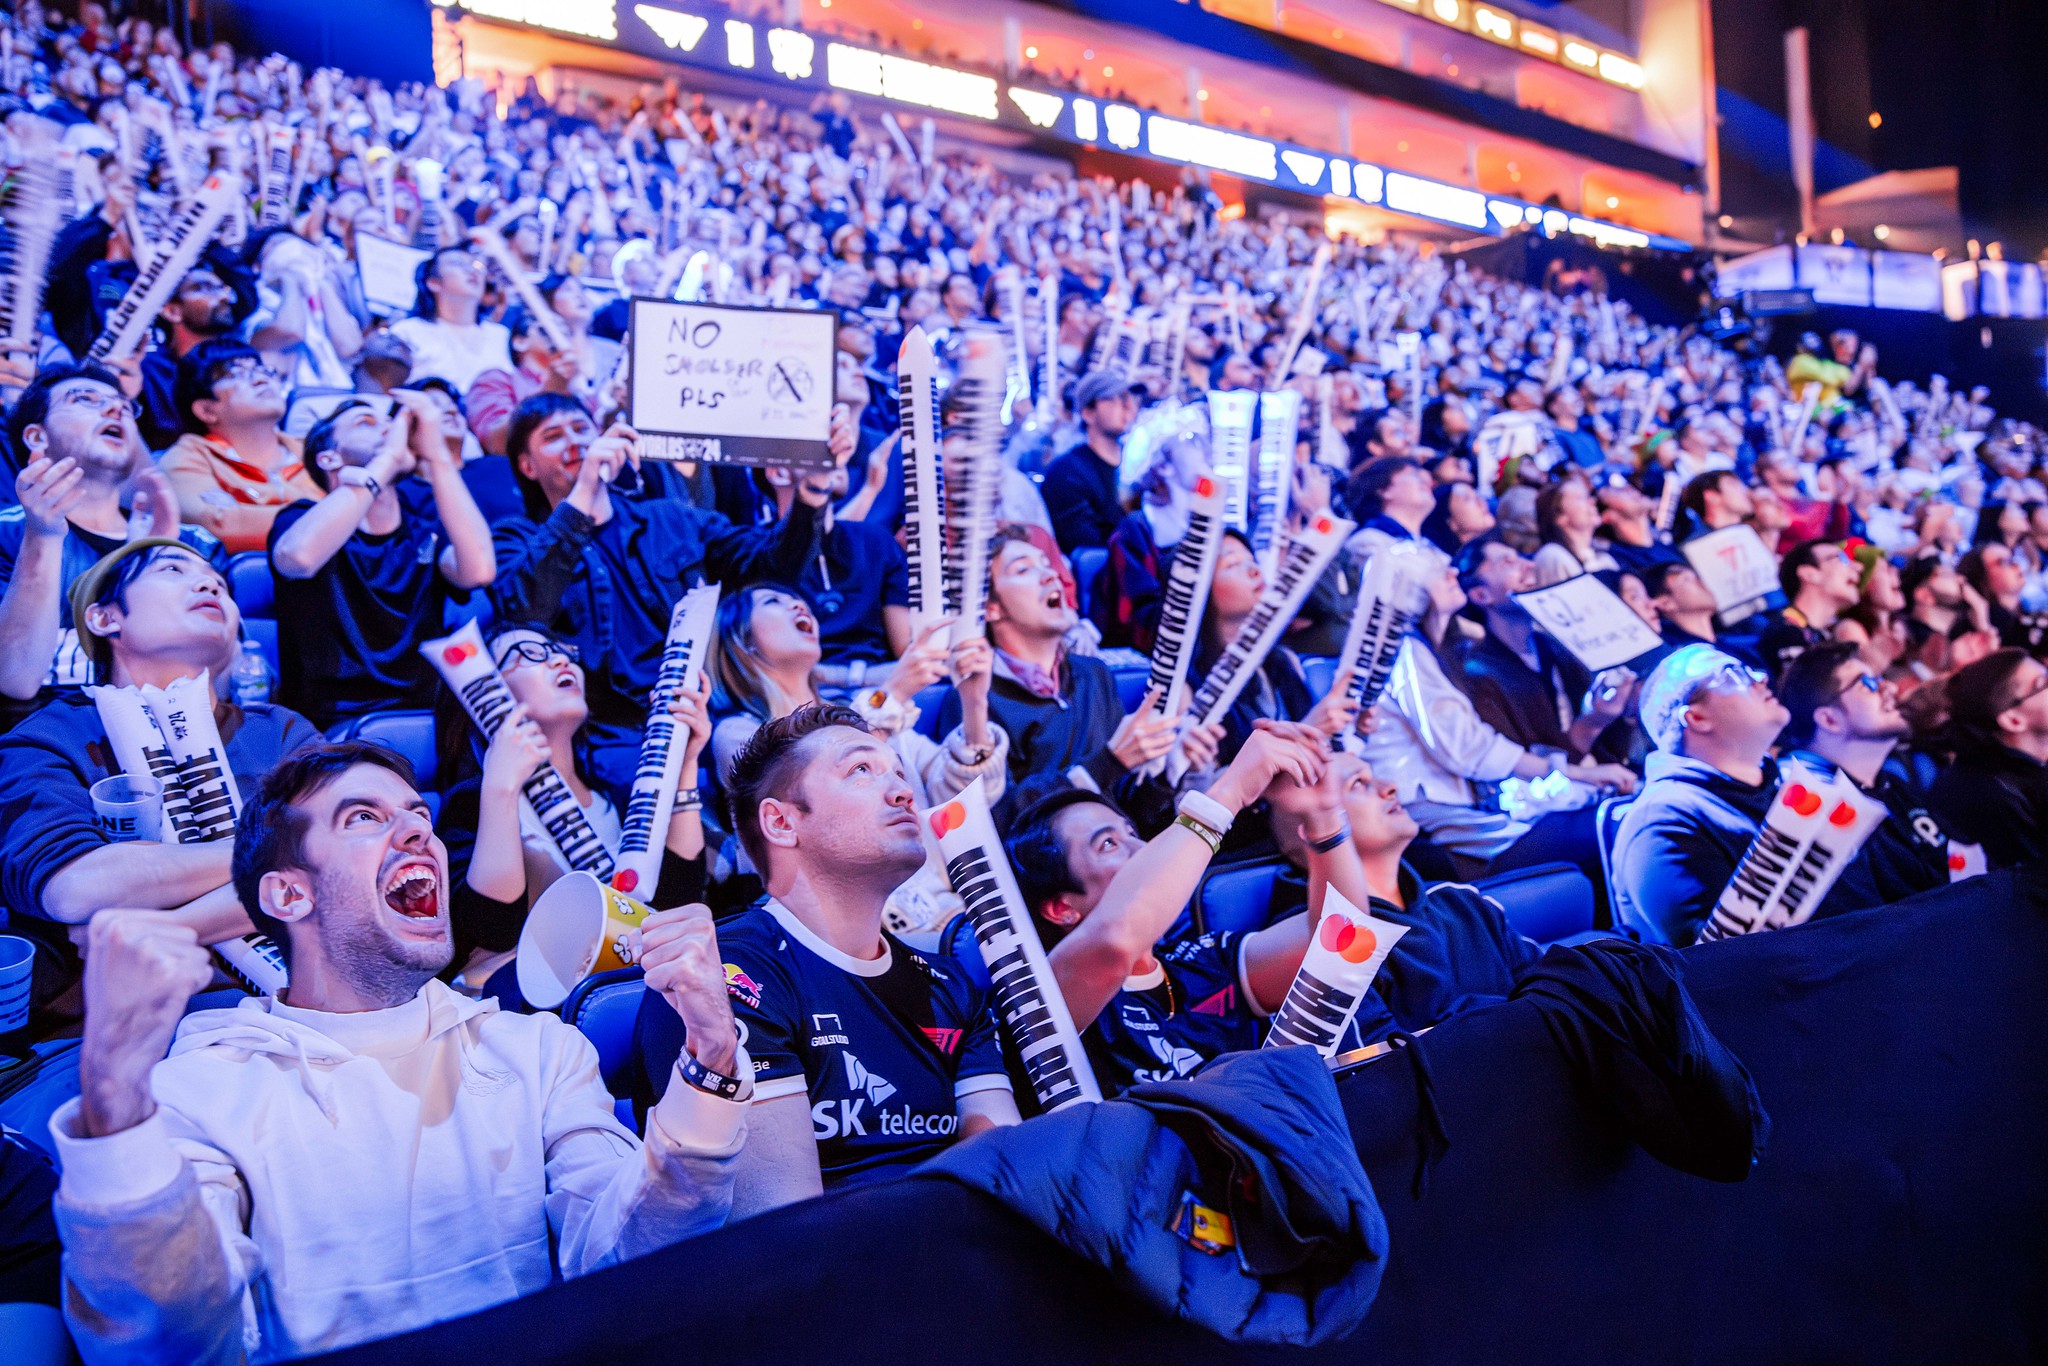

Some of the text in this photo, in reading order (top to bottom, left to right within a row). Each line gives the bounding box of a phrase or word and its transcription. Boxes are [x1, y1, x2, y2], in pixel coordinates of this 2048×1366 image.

[668, 317, 721, 349] NO
[680, 386, 725, 409] PLS
[702, 438, 722, 462] 24
[167, 709, 186, 726] 24
[173, 747, 237, 841] ELIEVE
[942, 844, 1019, 949] MAKE
[981, 943, 1058, 1049] THEM
[916, 1027, 964, 1055] T1
[810, 1098, 868, 1141] SK
